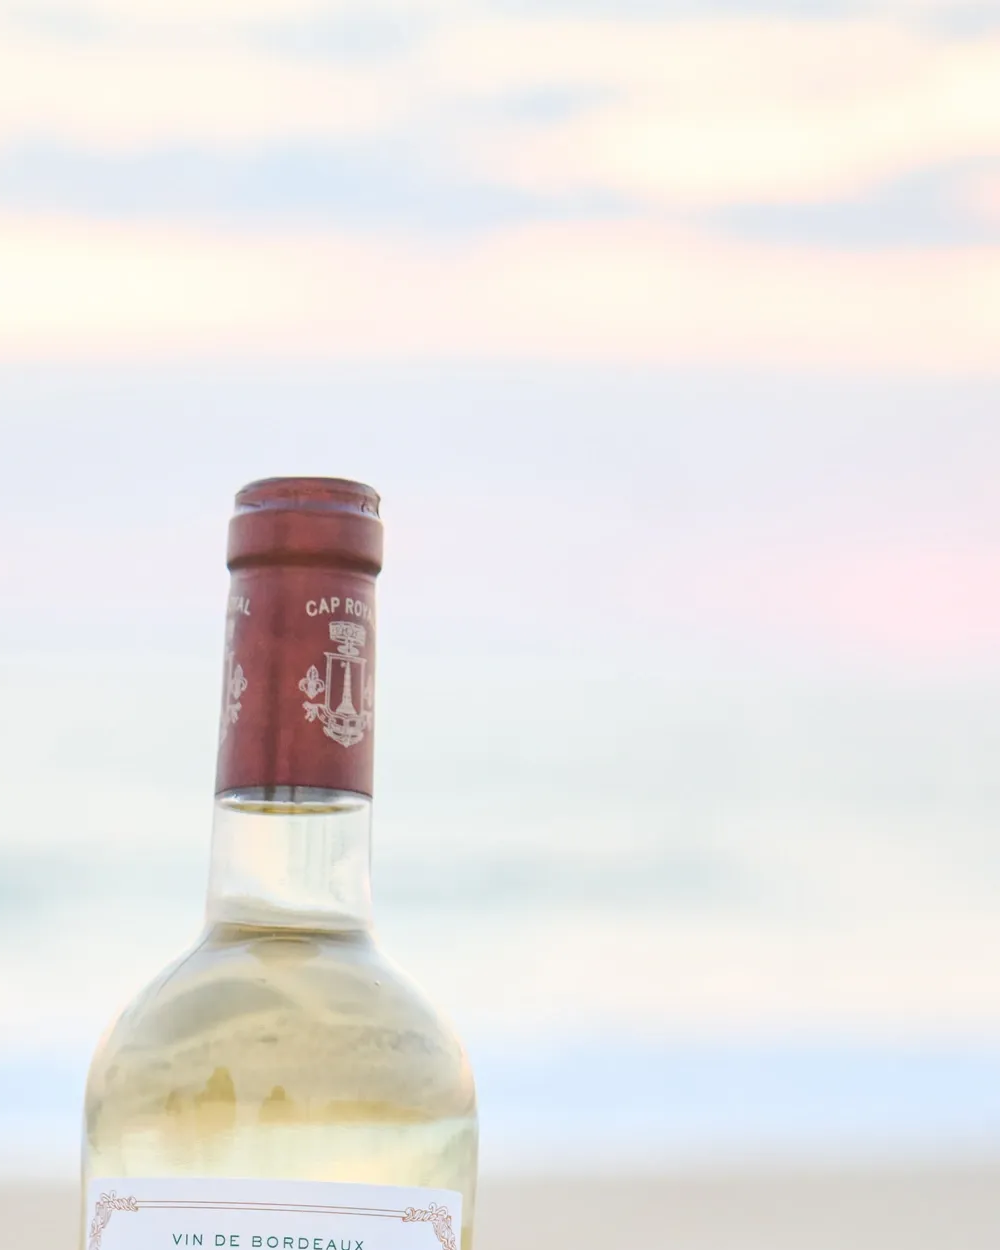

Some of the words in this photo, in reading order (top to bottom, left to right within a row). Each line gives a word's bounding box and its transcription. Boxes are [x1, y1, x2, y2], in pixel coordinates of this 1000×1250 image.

[305, 596, 341, 617] CAP
[172, 1233, 204, 1247] VIN
[214, 1233, 241, 1248] DE
